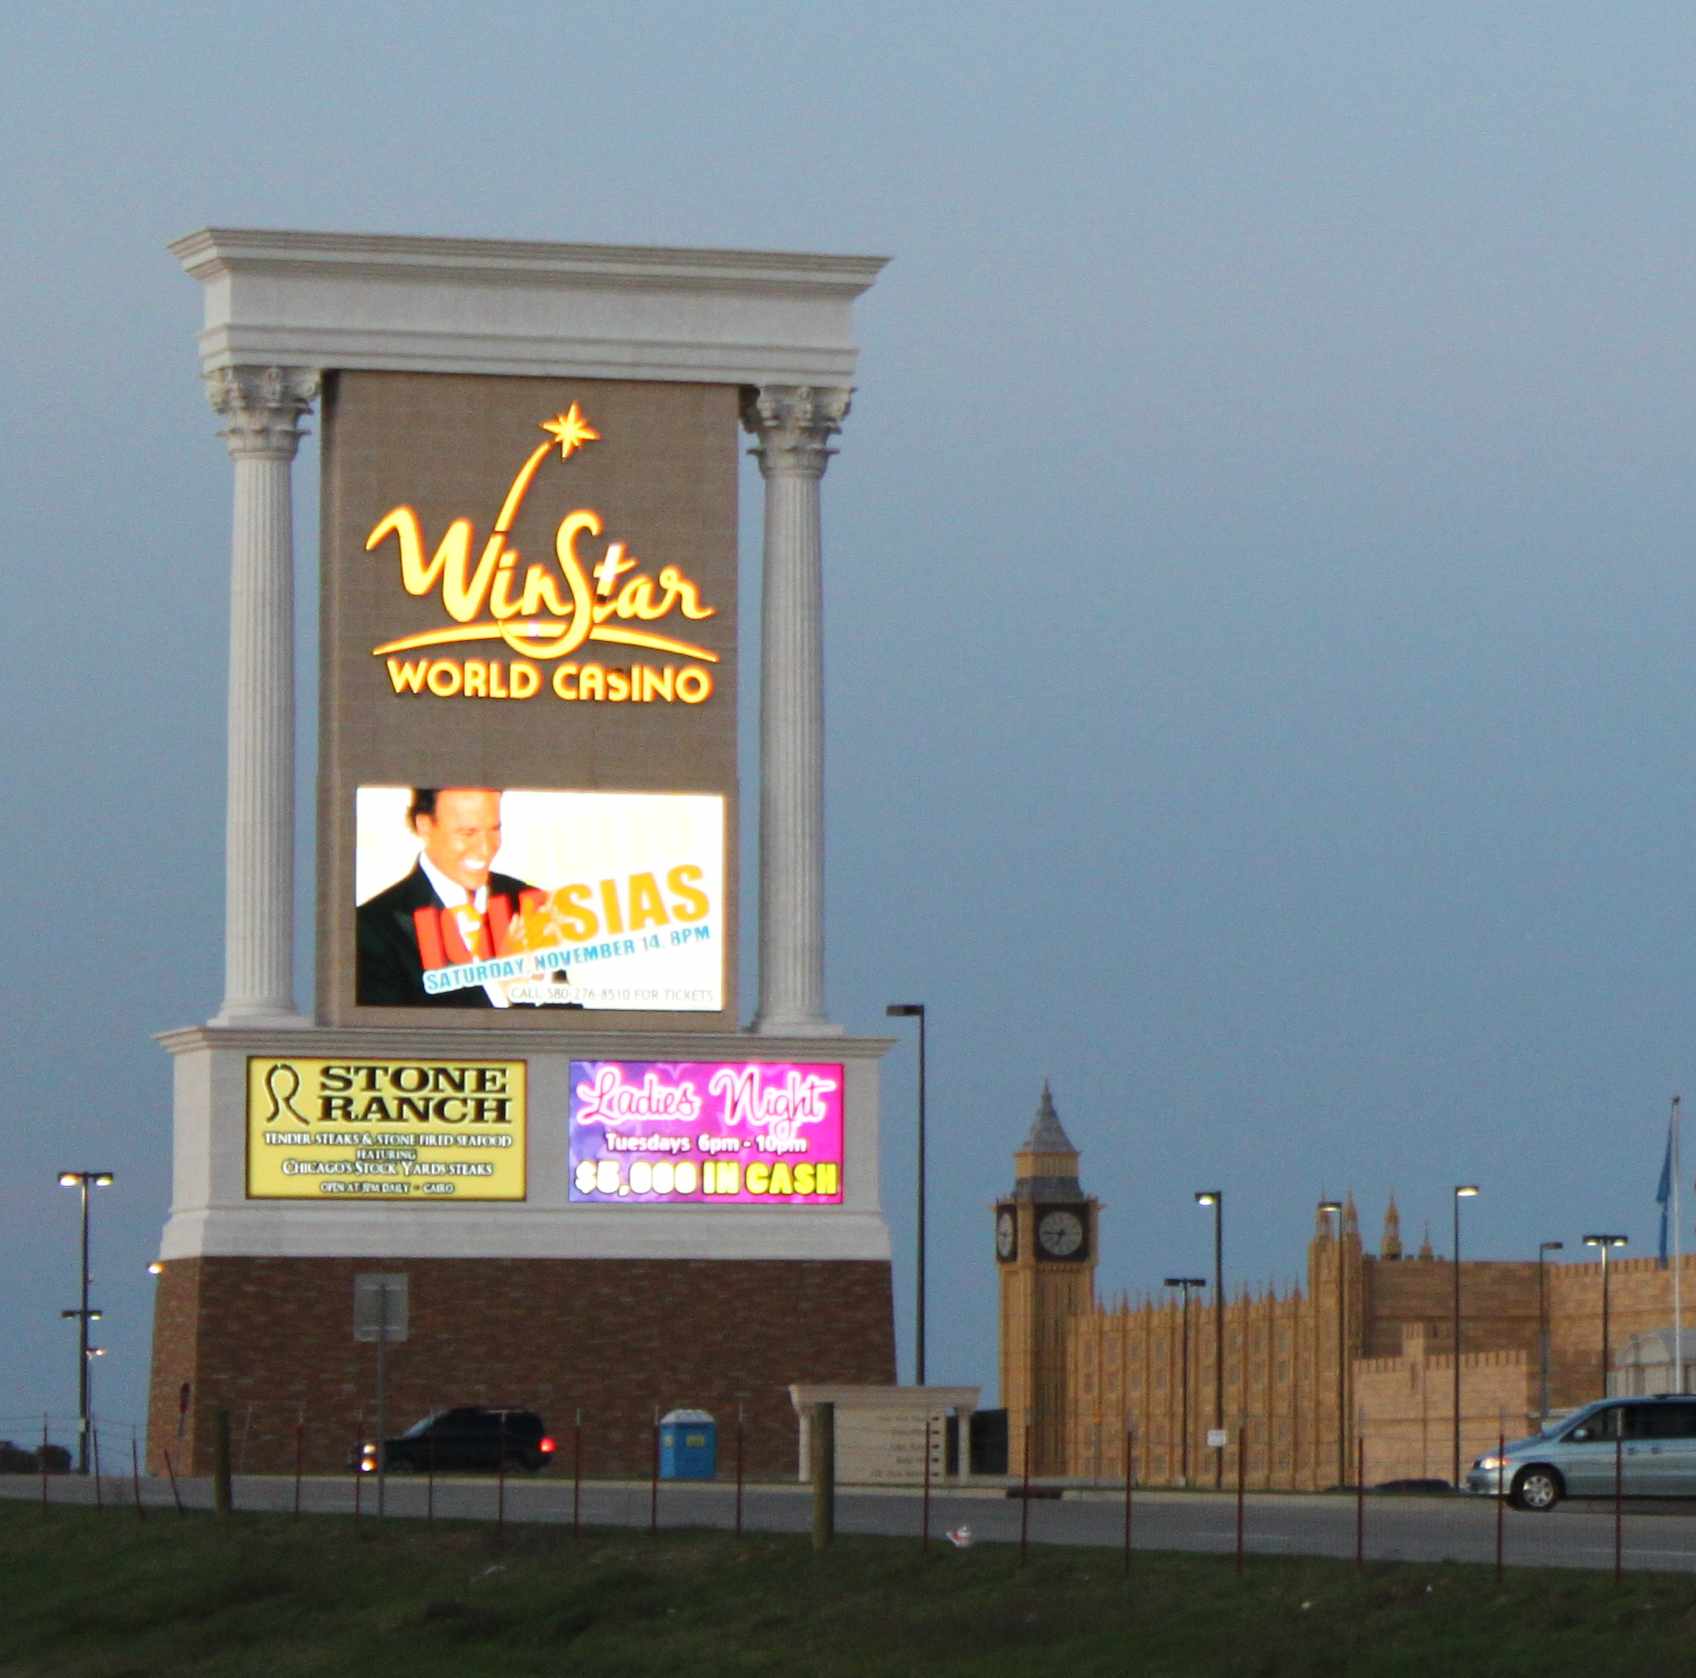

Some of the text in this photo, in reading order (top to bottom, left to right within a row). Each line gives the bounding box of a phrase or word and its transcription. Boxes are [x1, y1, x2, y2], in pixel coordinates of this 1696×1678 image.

[366, 505, 717, 660] WinStar
[386, 658, 714, 705] WORLD CASINO
[412, 863, 711, 970] IGLESIAS
[534, 939, 636, 971] NOVEMBER
[670, 924, 712, 946] 8PM
[510, 986, 541, 999] CALL
[634, 990, 659, 1001] FOR
[664, 990, 714, 1002] TICKETS
[319, 1065, 507, 1094] STONE
[317, 1096, 513, 1124] RANCH
[576, 1065, 837, 1142] Ladies Night
[264, 1131, 512, 1148] TENDER STEAKS & STONE FIRED SEAFOOD
[606, 1132, 690, 1154] Tuesdays
[698, 1134, 740, 1155] 6pm
[756, 1135, 808, 1155] 10pm
[354, 1160, 396, 1176] STOCK
[402, 1161, 448, 1177] YARDS
[448, 1163, 493, 1176] STEAKS
[356, 1149, 418, 1161] FEATURING
[319, 1182, 346, 1193] OPEN
[347, 1182, 360, 1193] AT
[574, 1160, 839, 1195] $5,000 IN CASH
